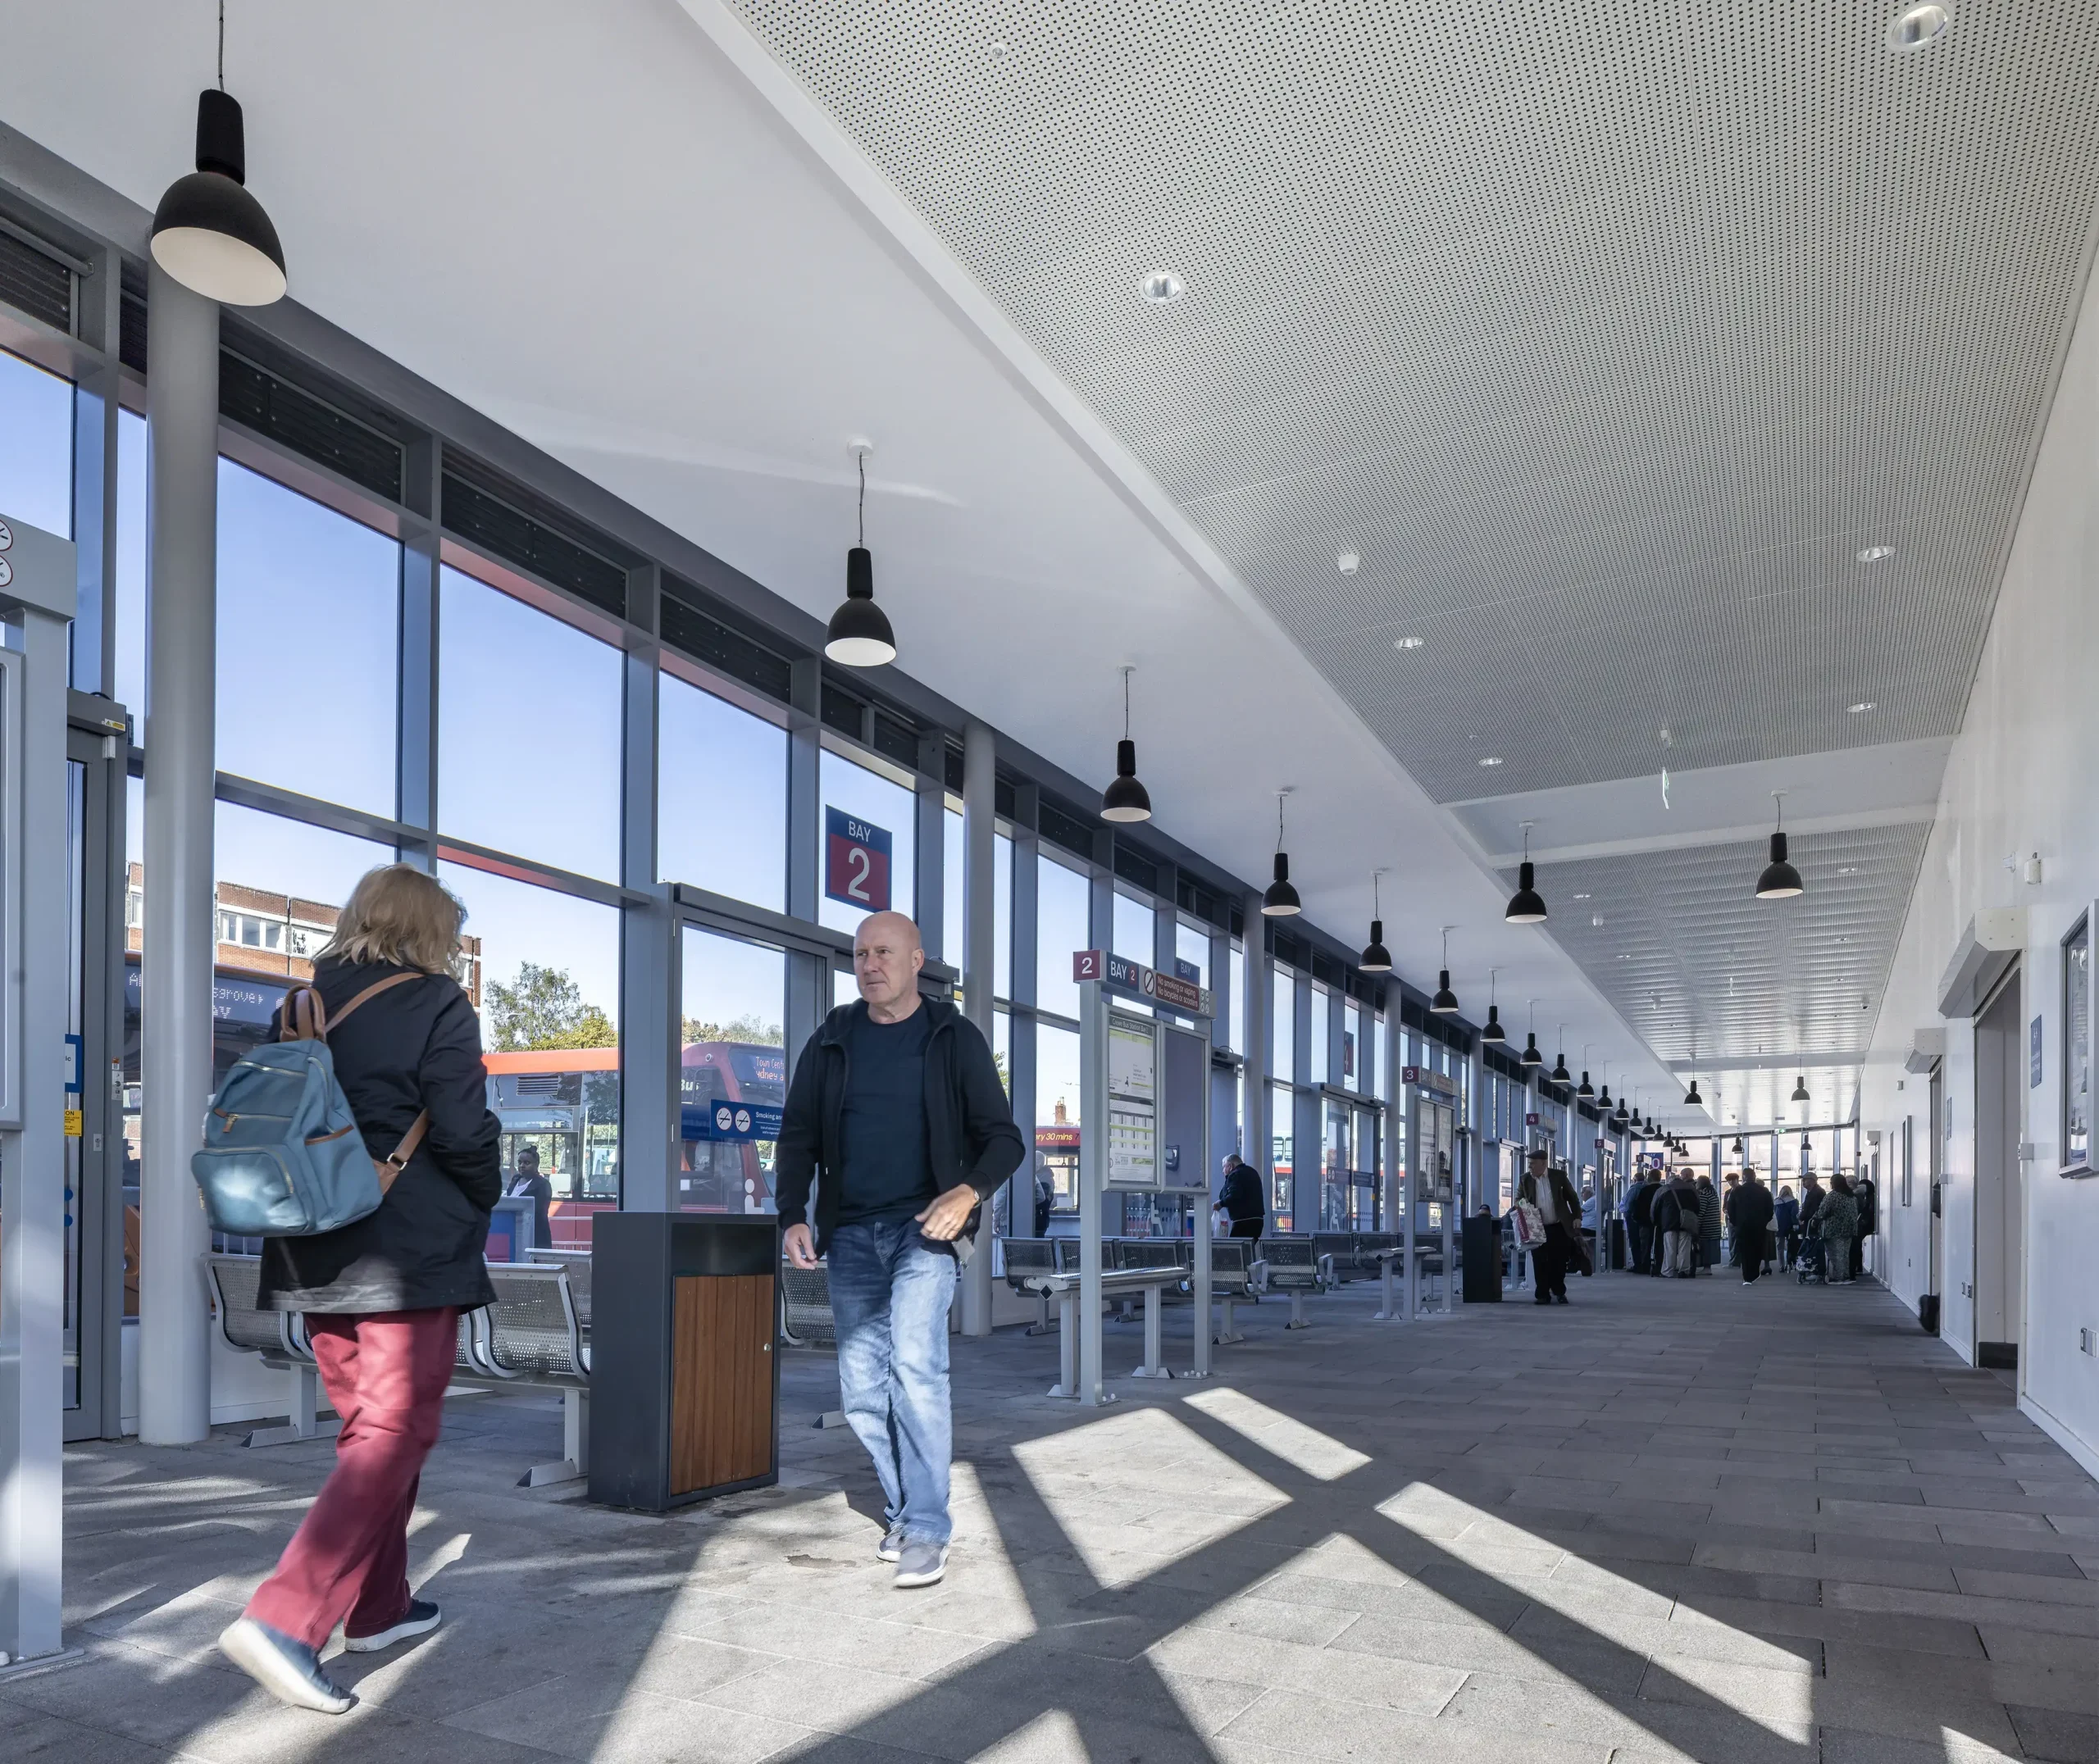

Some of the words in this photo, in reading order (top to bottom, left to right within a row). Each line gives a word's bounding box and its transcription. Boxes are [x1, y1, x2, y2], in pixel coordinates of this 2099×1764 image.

[849, 821, 871, 842] BAY
[848, 847, 870, 901] 2
[1082, 957, 1092, 974] 2
[1111, 960, 1127, 980] BAY
[1131, 970, 1135, 980] 2
[1181, 962, 1191, 975] BAY
[1158, 975, 1163, 984] No
[1164, 980, 1179, 993] smoking
[1185, 987, 1196, 998] vaping
[1158, 985, 1163, 995] No
[1164, 988, 1178, 1000] bicycles
[1183, 997, 1198, 1007] scooters
[1112, 1018, 1122, 1027] Crewe
[1129, 1022, 1141, 1031] Station
[755, 1056, 770, 1068] Town
[1406, 1070, 1414, 1080] 3
[755, 1111, 776, 1121] Smoking
[1045, 1132, 1056, 1140] 30
[1651, 1157, 1660, 1170] 0
